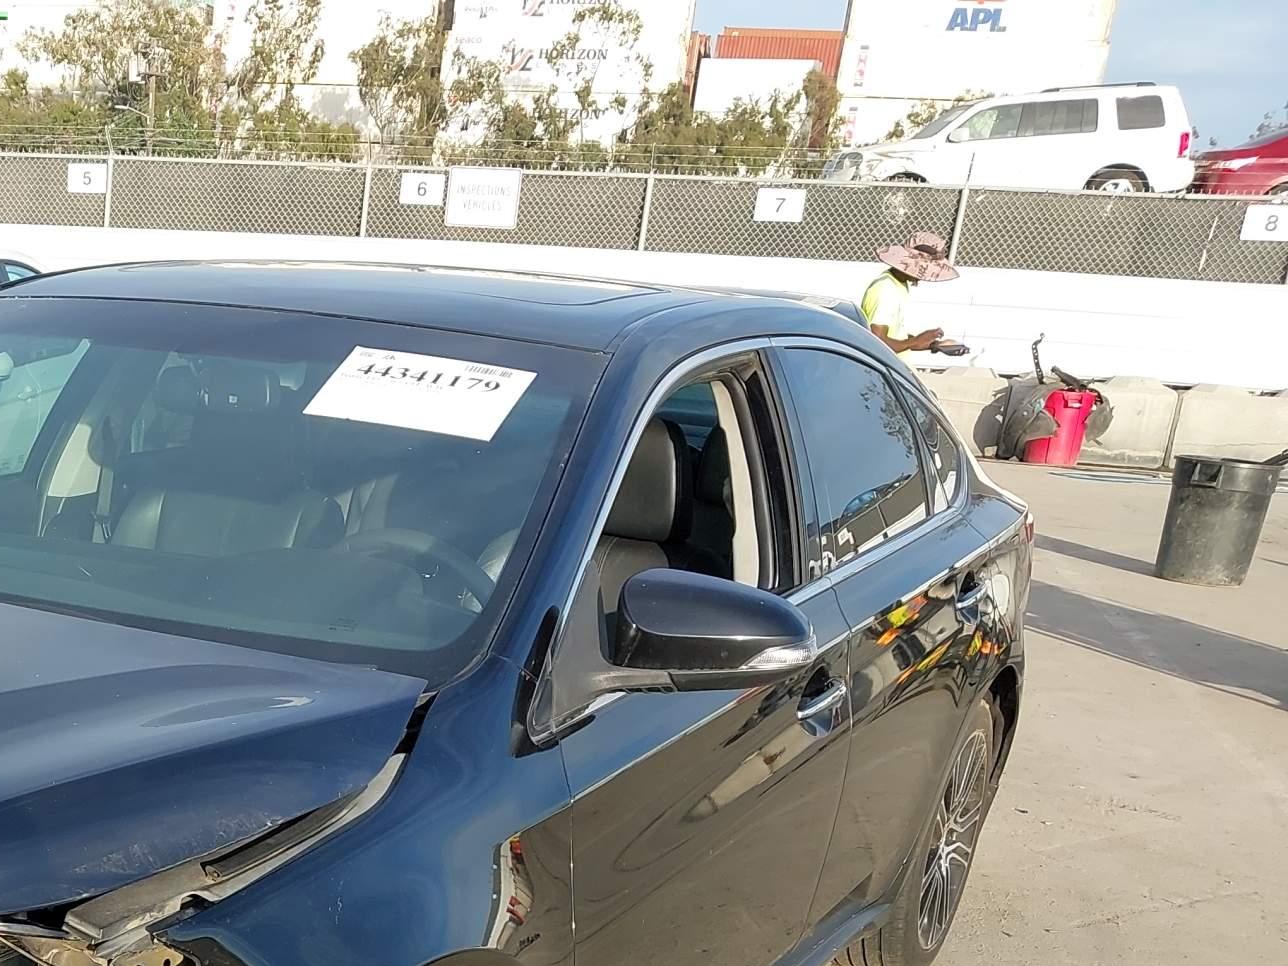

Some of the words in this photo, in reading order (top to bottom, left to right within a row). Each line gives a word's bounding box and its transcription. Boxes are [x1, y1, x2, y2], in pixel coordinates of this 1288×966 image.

[945, 7, 1007, 33] APL
[83, 171, 92, 186] 5
[417, 181, 428, 197] 6
[775, 197, 787, 213] 7
[1264, 214, 1279, 232] 8
[357, 362, 502, 393] 44341179
